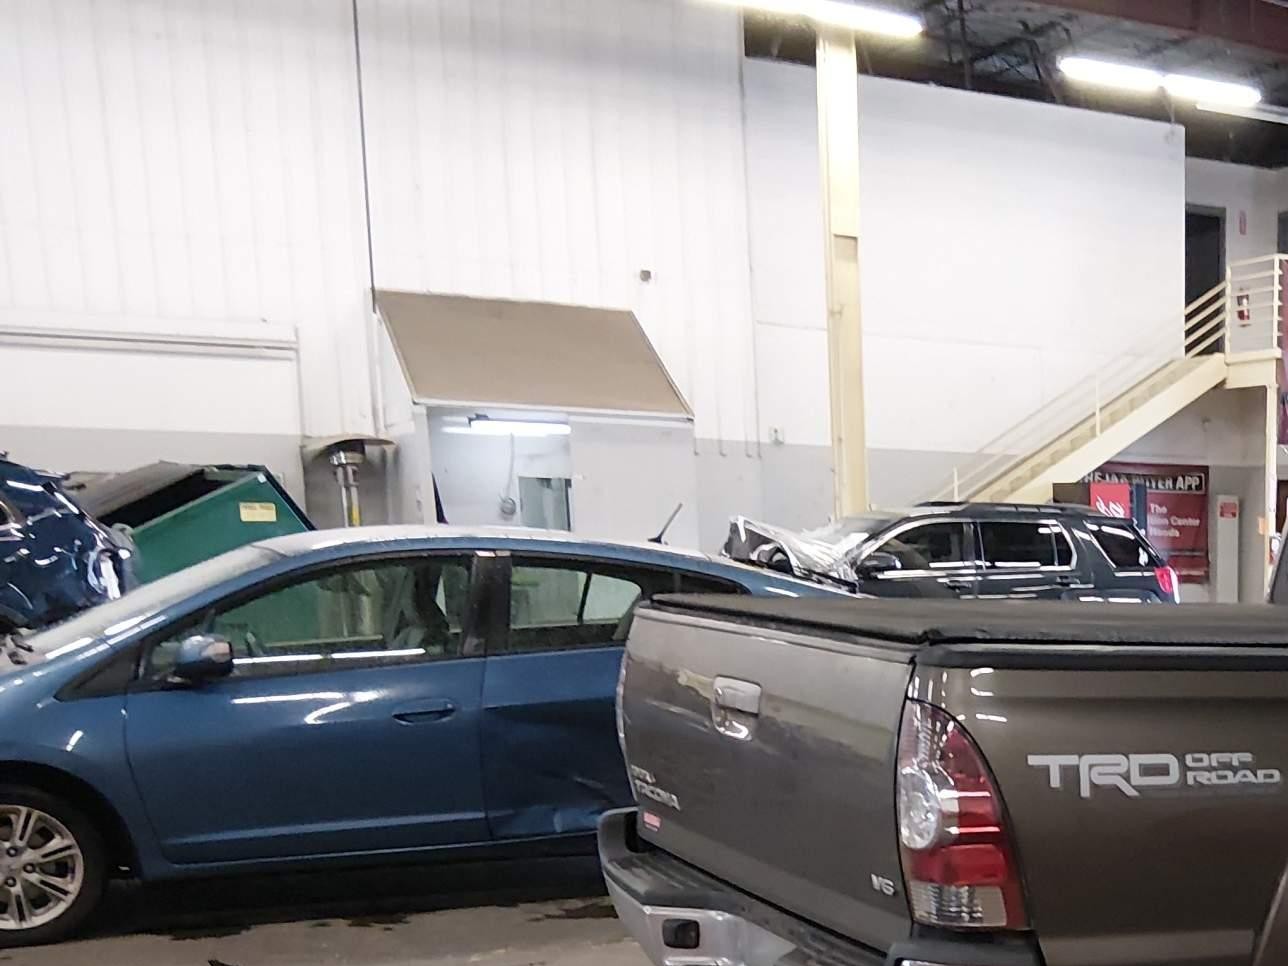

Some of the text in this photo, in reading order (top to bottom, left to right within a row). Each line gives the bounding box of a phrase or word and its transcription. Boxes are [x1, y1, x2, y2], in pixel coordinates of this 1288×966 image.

[1176, 475, 1200, 491] APP
[1027, 753, 1253, 798] TRD OFF
[1185, 769, 1281, 785] ROAD
[871, 873, 895, 896] V6
